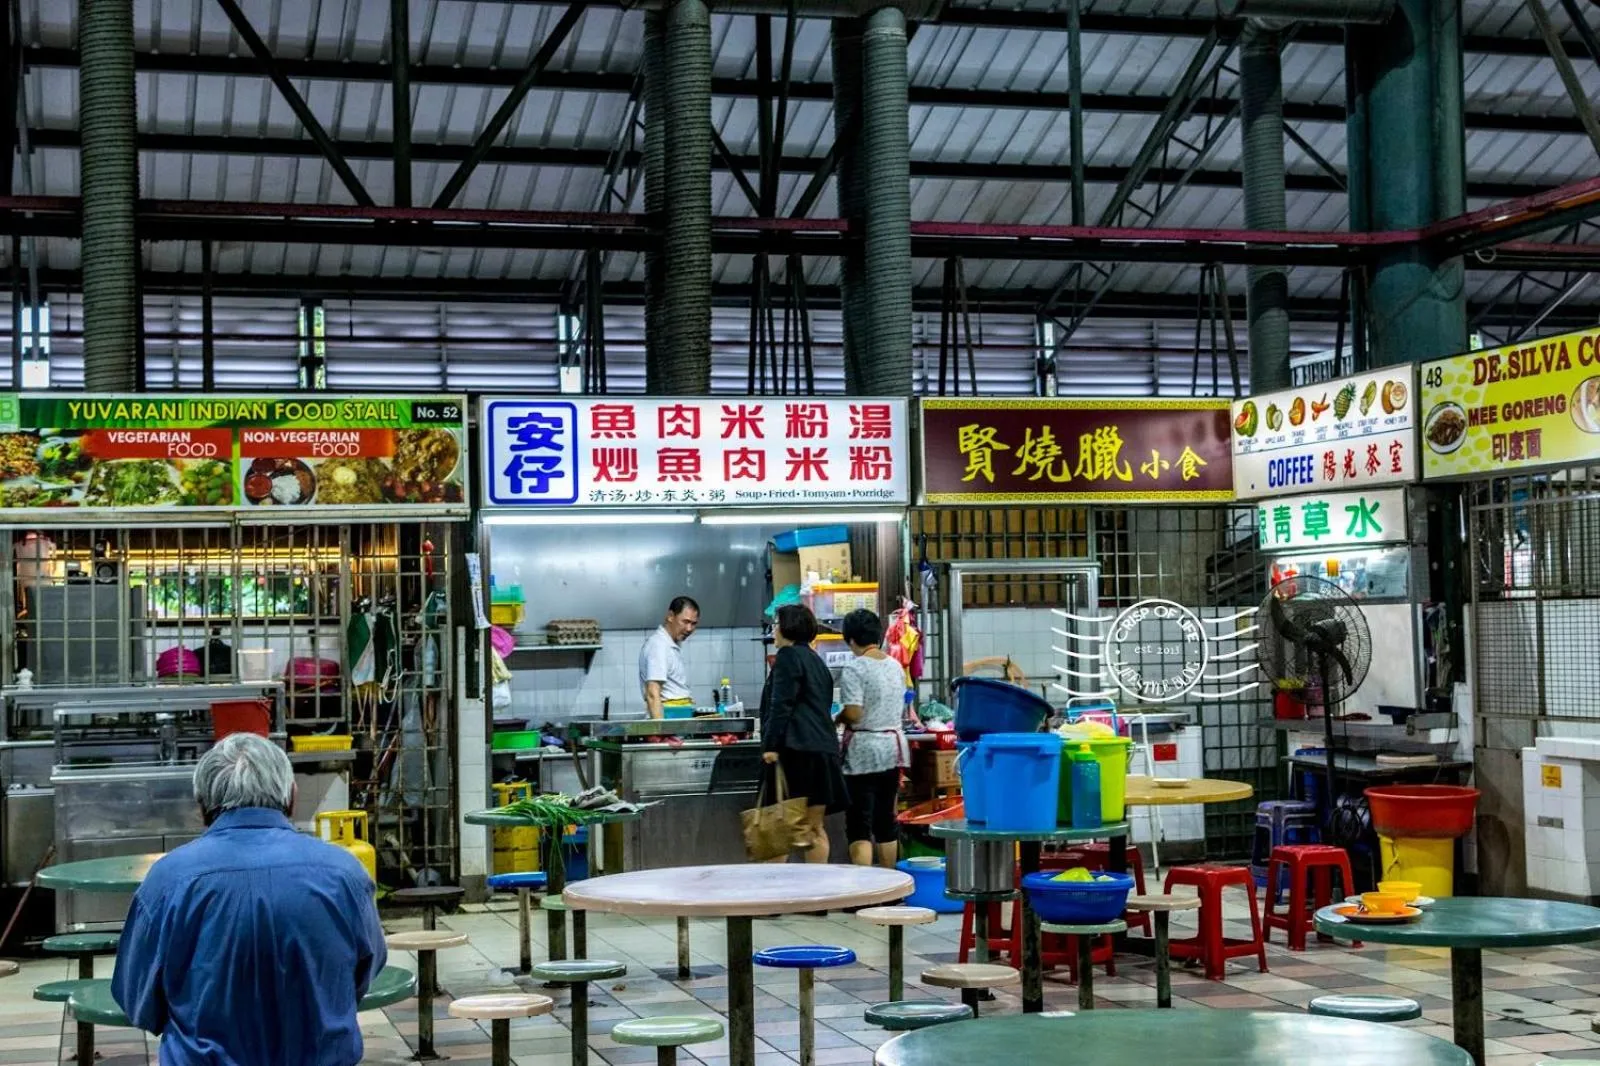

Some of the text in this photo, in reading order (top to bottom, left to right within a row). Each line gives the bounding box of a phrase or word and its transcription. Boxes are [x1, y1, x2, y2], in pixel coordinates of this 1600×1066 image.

[1473, 341, 1572, 386] DE.SILVA
[1425, 366, 1443, 389] 48
[68, 402, 398, 420] YUVARANI INDIAN FOOD STALL
[417, 406, 459, 419] No. 52
[590, 403, 893, 440] 魚肉米粉湯
[1468, 393, 1567, 428] MEE GORENG
[108, 431, 191, 443] VEGETARIAN
[243, 431, 360, 443] NON-VEGETARIAN
[168, 443, 217, 456] FOOD
[312, 443, 360, 456] FOOD
[503, 412, 565, 495] 安仔
[591, 446, 893, 483] 炒魚肉米粉
[1268, 454, 1314, 488] COFFEE
